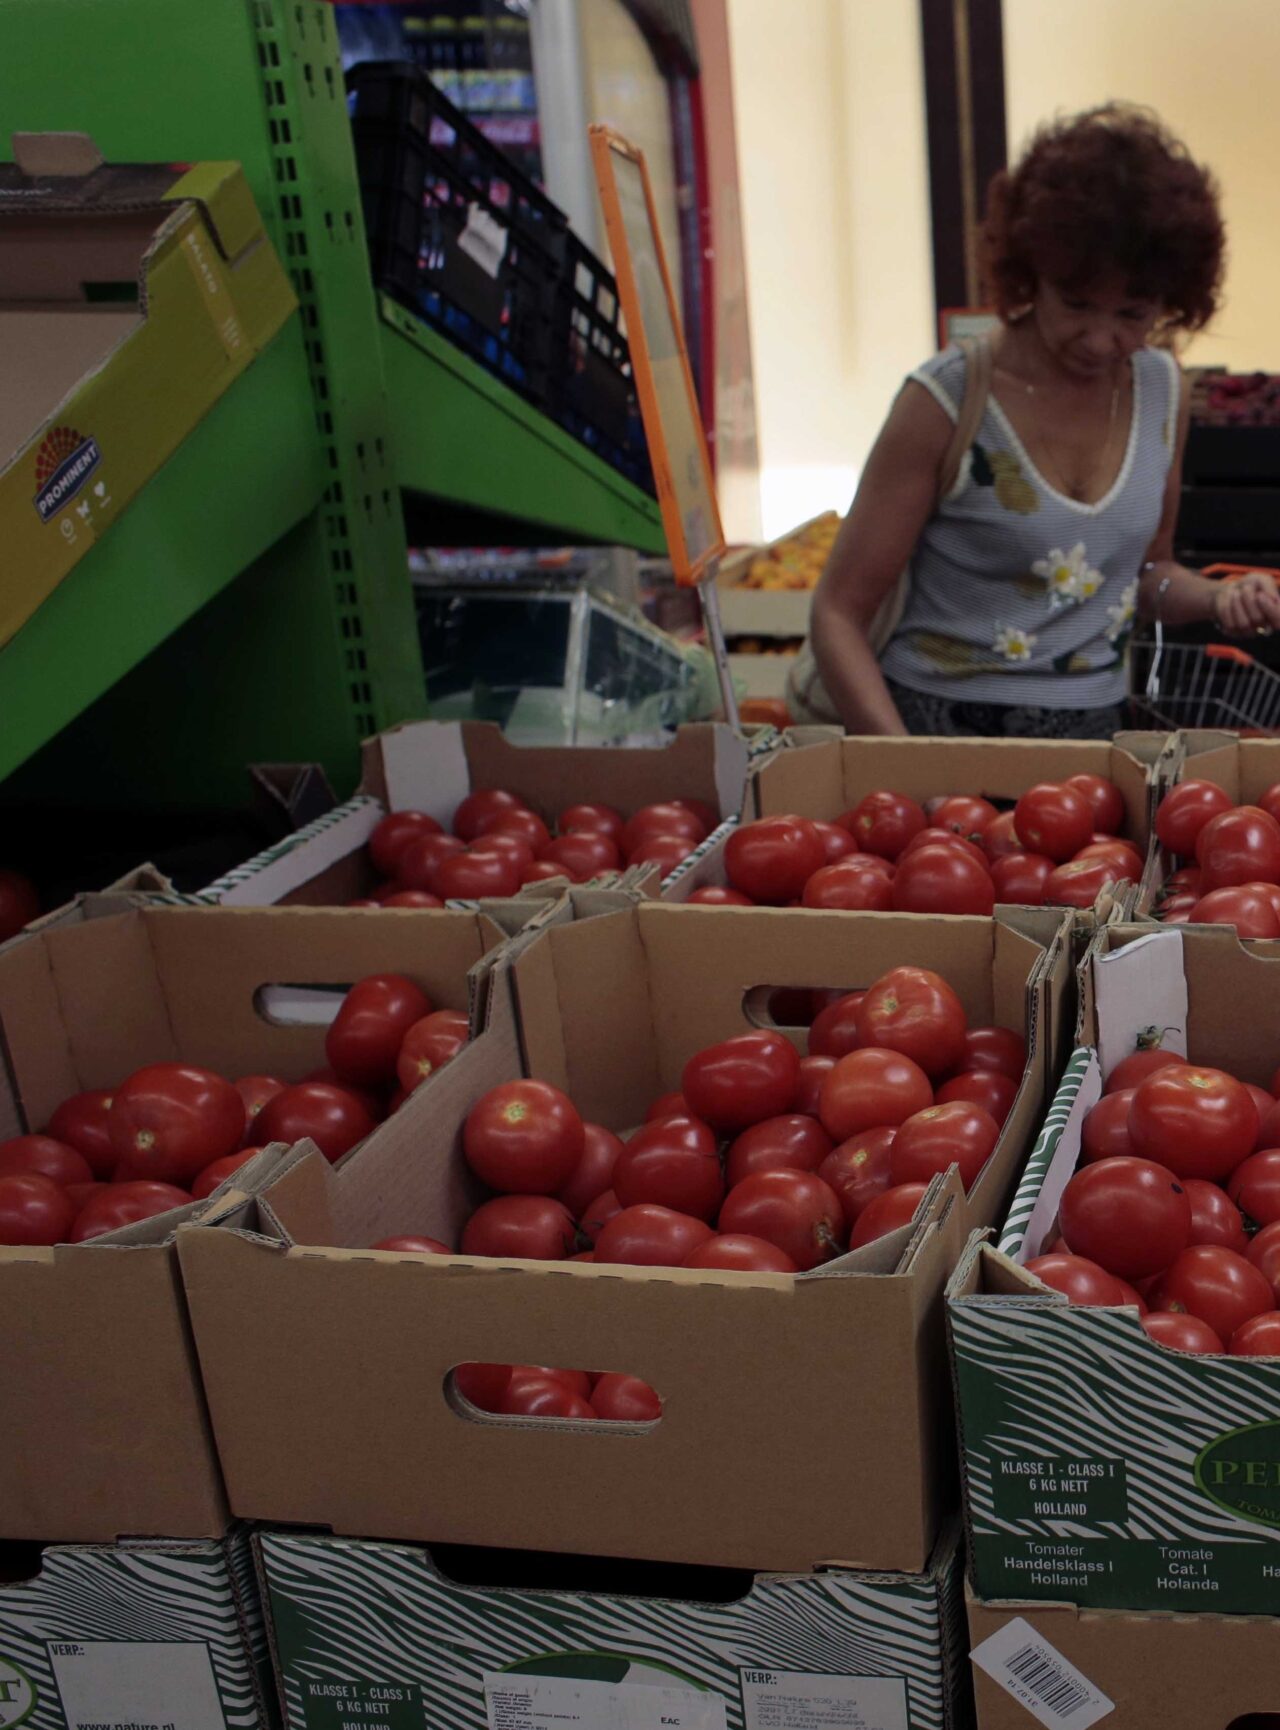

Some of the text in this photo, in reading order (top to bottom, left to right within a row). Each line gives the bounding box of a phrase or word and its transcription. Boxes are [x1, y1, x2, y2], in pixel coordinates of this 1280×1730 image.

[39, 444, 97, 515] PROMINENT
[1001, 1461, 1045, 1475] KLASSE
[1067, 1463, 1105, 1477] CLASS
[1029, 1478, 1089, 1493] 6 KG NETT
[1034, 1502, 1088, 1516] HOLLAND
[1025, 1541, 1085, 1557] Tomater
[1158, 1546, 1214, 1561] Tomate
[1004, 1556, 1105, 1572] Handelsklass
[1168, 1562, 1199, 1576] Cat.
[1030, 1572, 1089, 1587] Holland
[1156, 1576, 1220, 1591] Holanda
[744, 1671, 778, 1685] VERP.:
[309, 1684, 349, 1698] KLASSE
[369, 1687, 404, 1700] CLASS
[336, 1700, 390, 1715] 6 KG NETT
[660, 1716, 681, 1726] EAC
